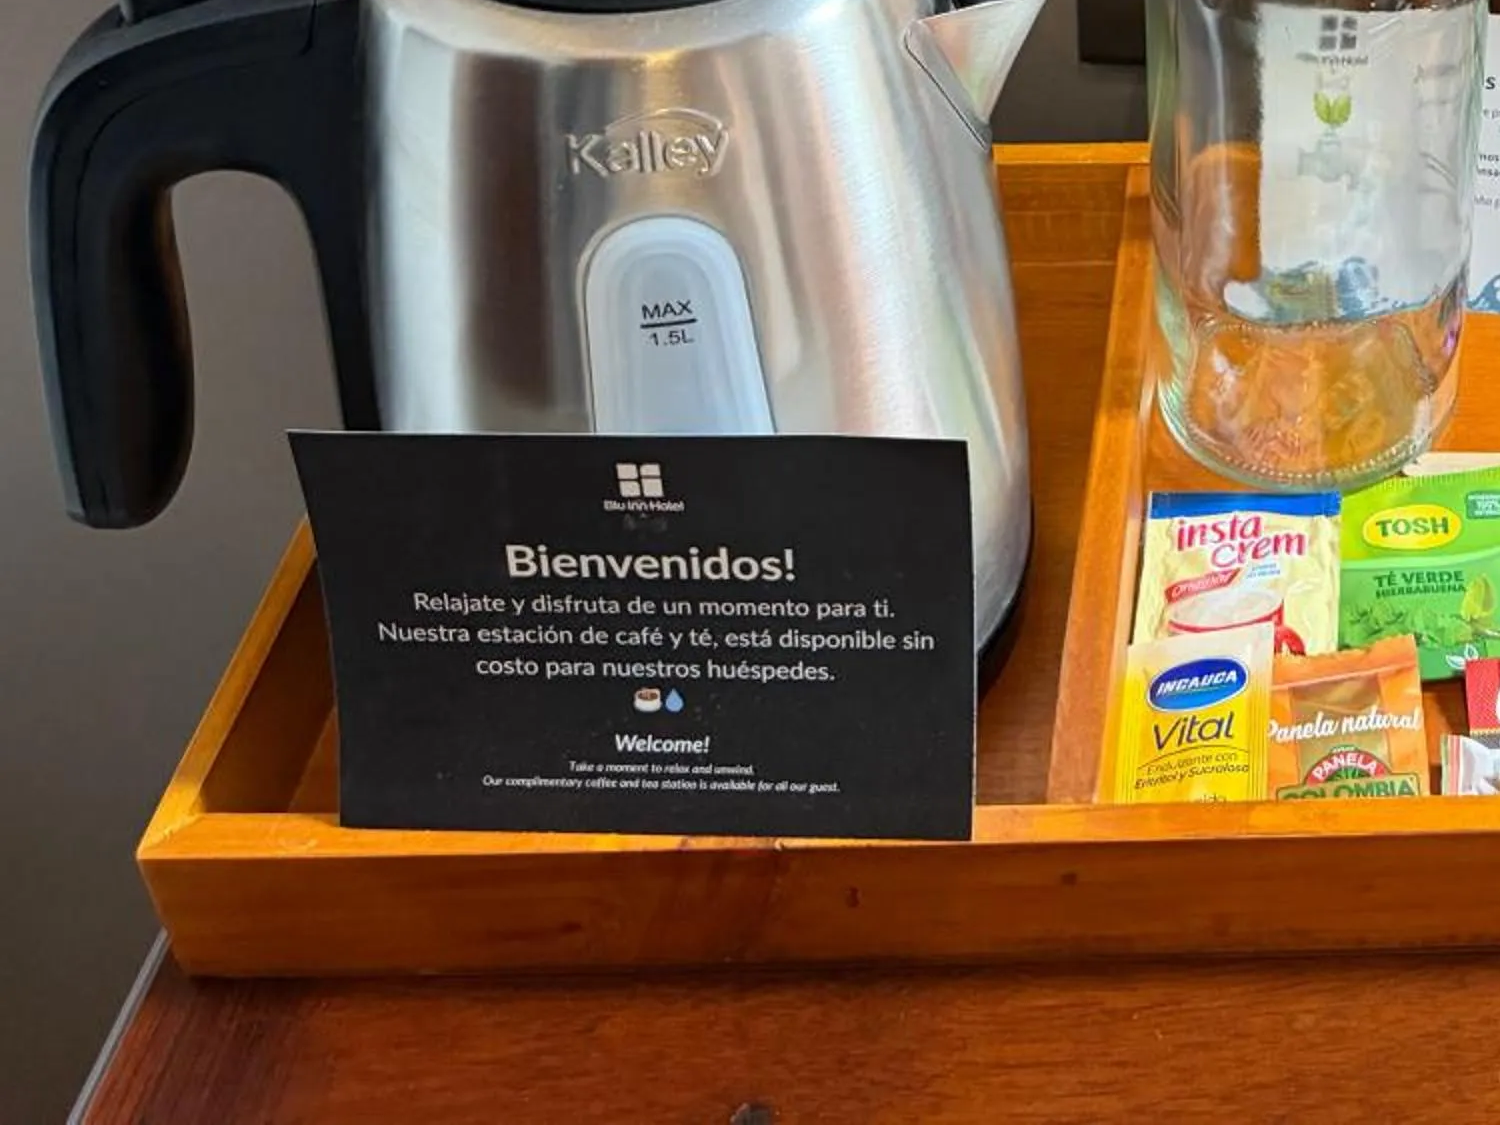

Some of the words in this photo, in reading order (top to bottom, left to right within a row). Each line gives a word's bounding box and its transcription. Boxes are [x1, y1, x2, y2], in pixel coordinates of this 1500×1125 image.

[566, 130, 730, 177] Kalley
[642, 299, 694, 320] MAX
[650, 329, 695, 347] 1.5L
[1177, 515, 1263, 552] insta
[1375, 516, 1450, 538] TOSH
[505, 543, 797, 582] Bienvenidos!
[1373, 571, 1398, 588] TÉ
[1401, 570, 1465, 585] VERDE
[413, 591, 506, 616] Relajate
[512, 597, 526, 616] y
[532, 594, 621, 615] disfruta
[627, 596, 659, 615] de
[663, 600, 693, 616] un
[699, 599, 811, 618] momento
[816, 602, 868, 620] para
[873, 599, 896, 619] ti.
[377, 622, 471, 643] Nuestra
[476, 624, 574, 645] estación
[579, 627, 609, 645] de
[614, 626, 664, 646] café
[669, 632, 684, 650] y
[689, 628, 719, 649] té,
[724, 629, 773, 648] está
[778, 629, 897, 652] disponible
[902, 631, 935, 651] sin
[475, 658, 539, 676] costo
[545, 660, 596, 679] para
[602, 660, 701, 679] nuestros
[707, 659, 836, 684] huéspedes.
[1156, 669, 1238, 696] INCAUCA
[1153, 711, 1235, 751] Vital
[1267, 711, 1339, 743] Panela
[1341, 704, 1422, 736] natural
[615, 733, 711, 755] Welcome!
[569, 760, 595, 773] Take
[596, 764, 605, 773] a
[605, 763, 649, 773] moment
[651, 763, 663, 773] to
[663, 763, 690, 774] relax
[691, 764, 713, 775] and
[1312, 752, 1378, 781] PANELA
[482, 775, 503, 787] Our
[505, 776, 583, 789] complimentary
[585, 776, 617, 789] coffee
[619, 778, 640, 789] and
[642, 778, 660, 789] tea
[661, 779, 697, 791] station
[700, 779, 707, 790] is
[710, 779, 756, 791] available
[758, 780, 774, 793] for
[775, 780, 789, 791] all
[789, 782, 807, 792] our
[1283, 779, 1415, 798] LOMBIA
